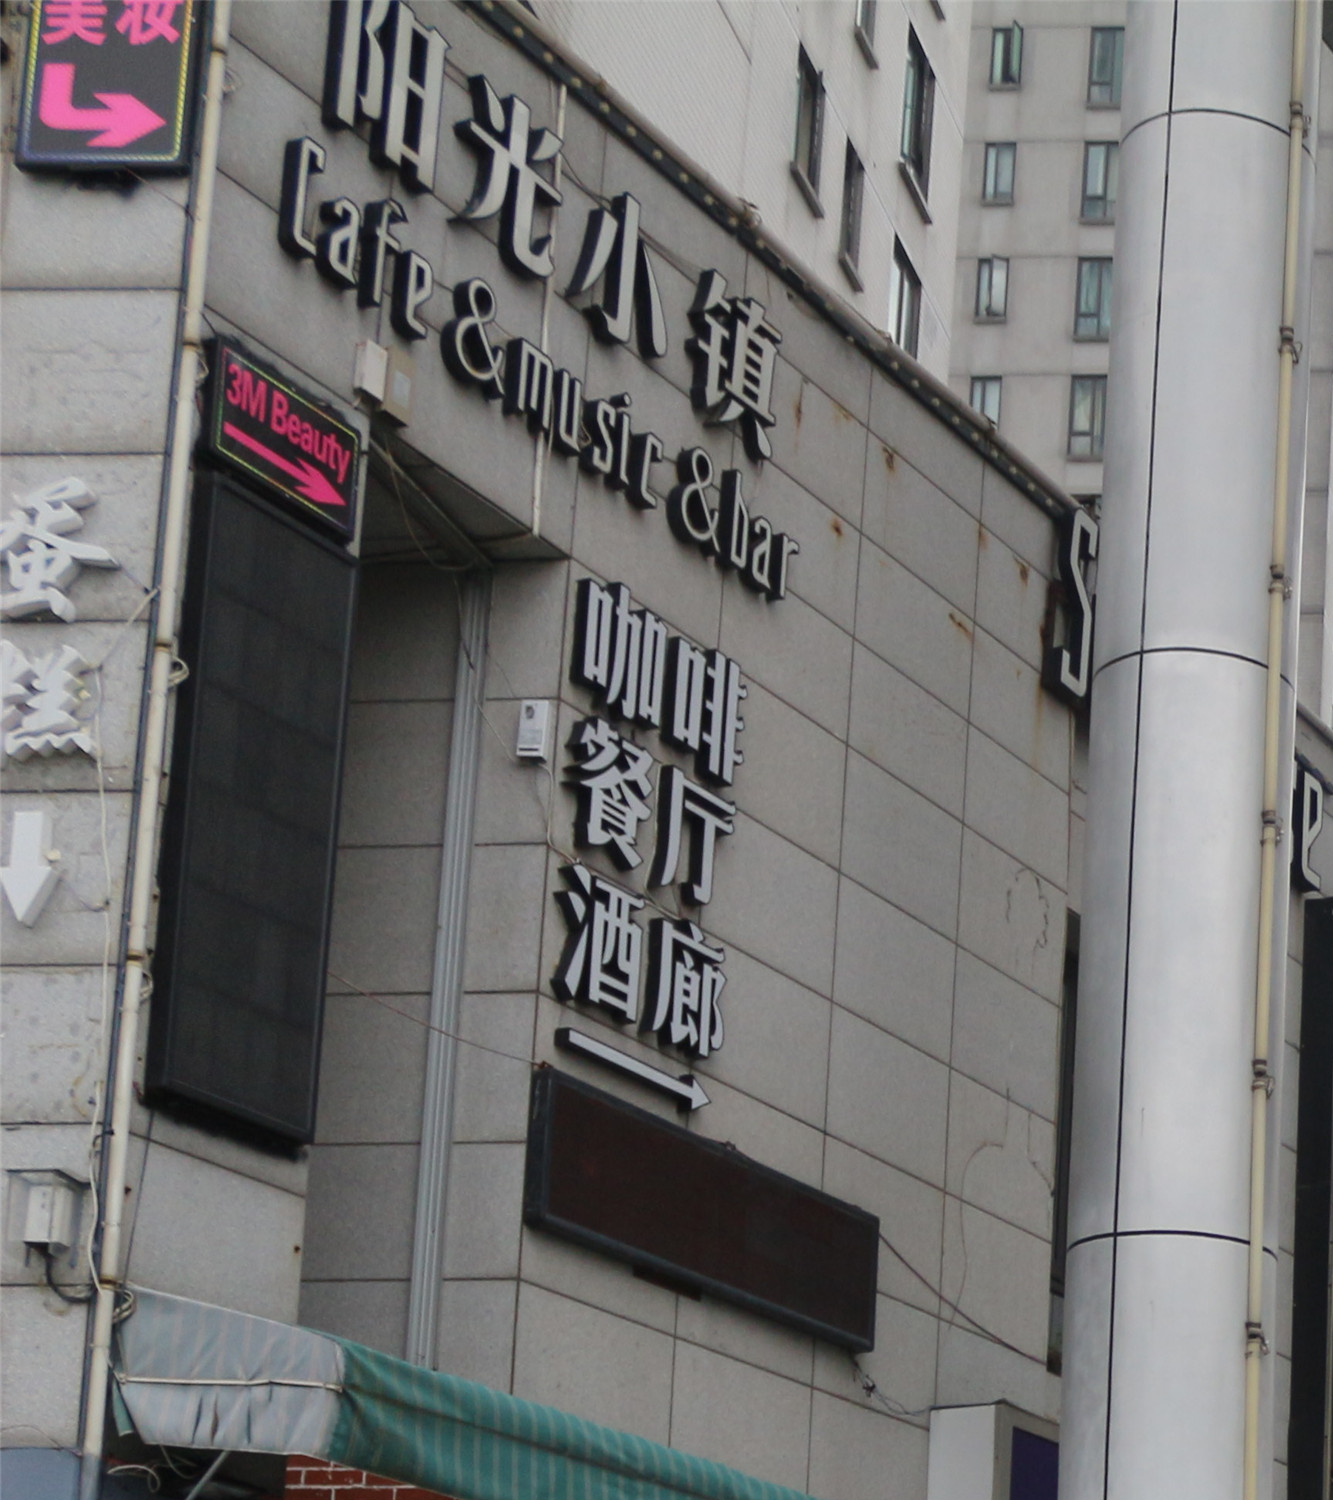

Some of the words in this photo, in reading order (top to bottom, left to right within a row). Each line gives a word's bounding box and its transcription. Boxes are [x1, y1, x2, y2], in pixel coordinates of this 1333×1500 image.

[278, 135, 434, 339] Cafe
[322, 0, 782, 461] 阳光小镇
[226, 362, 269, 423] 3M
[270, 388, 351, 485] Beauty
[570, 577, 749, 787] 咖啡
[562, 716, 737, 905] 餐厅
[551, 863, 728, 1059] 酒廊
